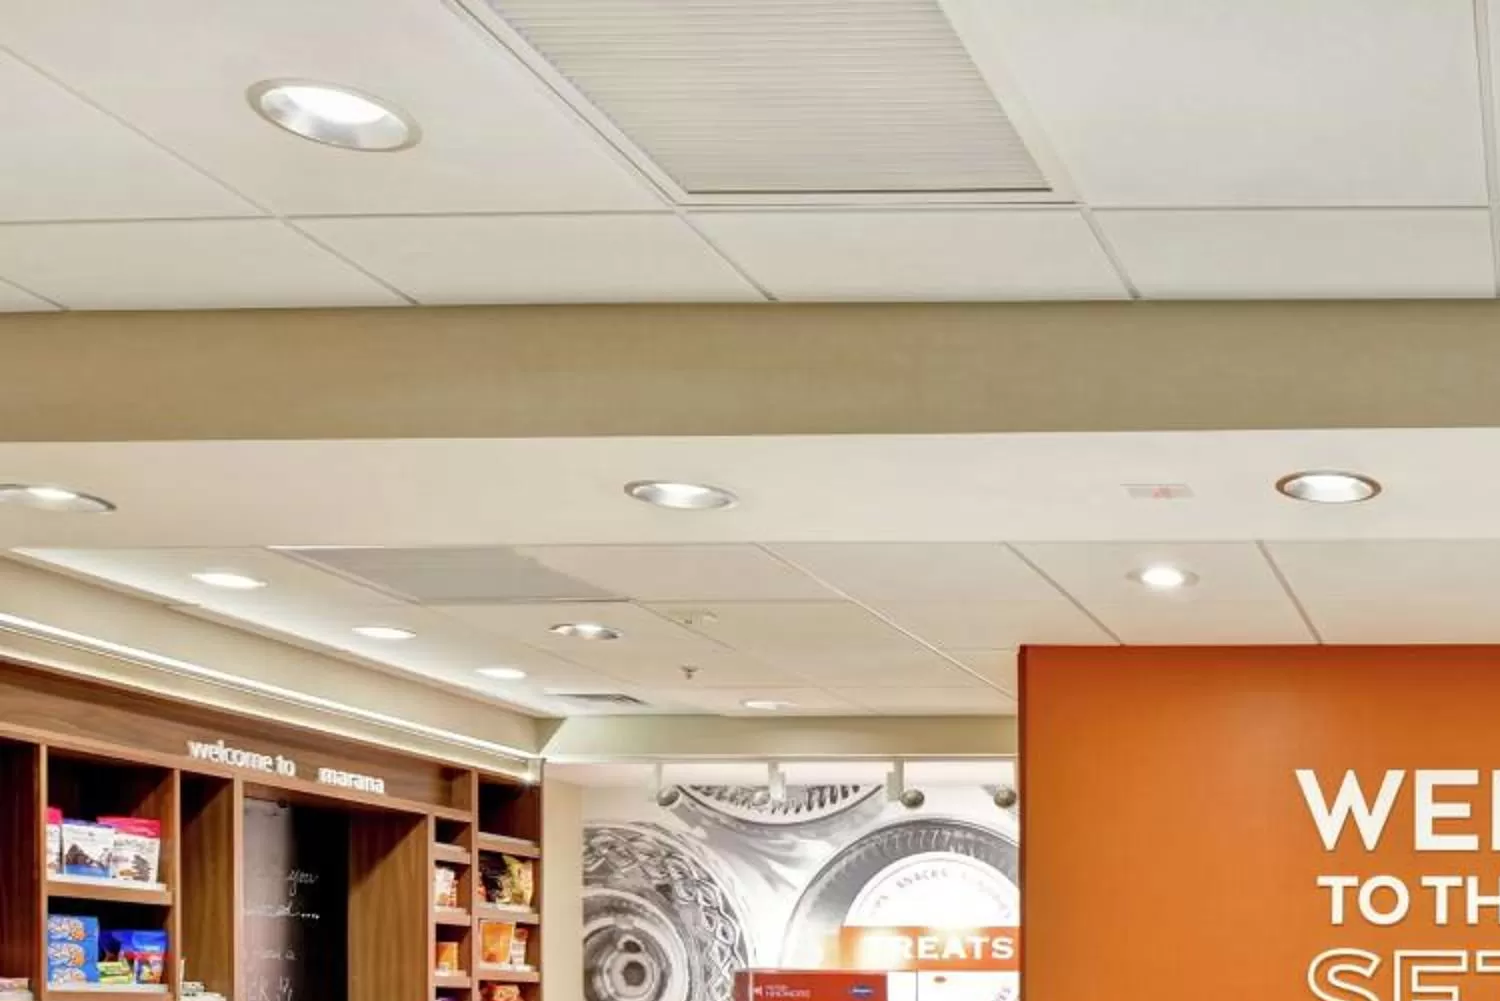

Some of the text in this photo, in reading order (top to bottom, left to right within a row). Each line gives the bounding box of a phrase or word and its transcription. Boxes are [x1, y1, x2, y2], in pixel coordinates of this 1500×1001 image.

[187, 740, 385, 794] welcome to marana
[1317, 875, 1410, 926] TO
[864, 935, 1015, 961] REATS
